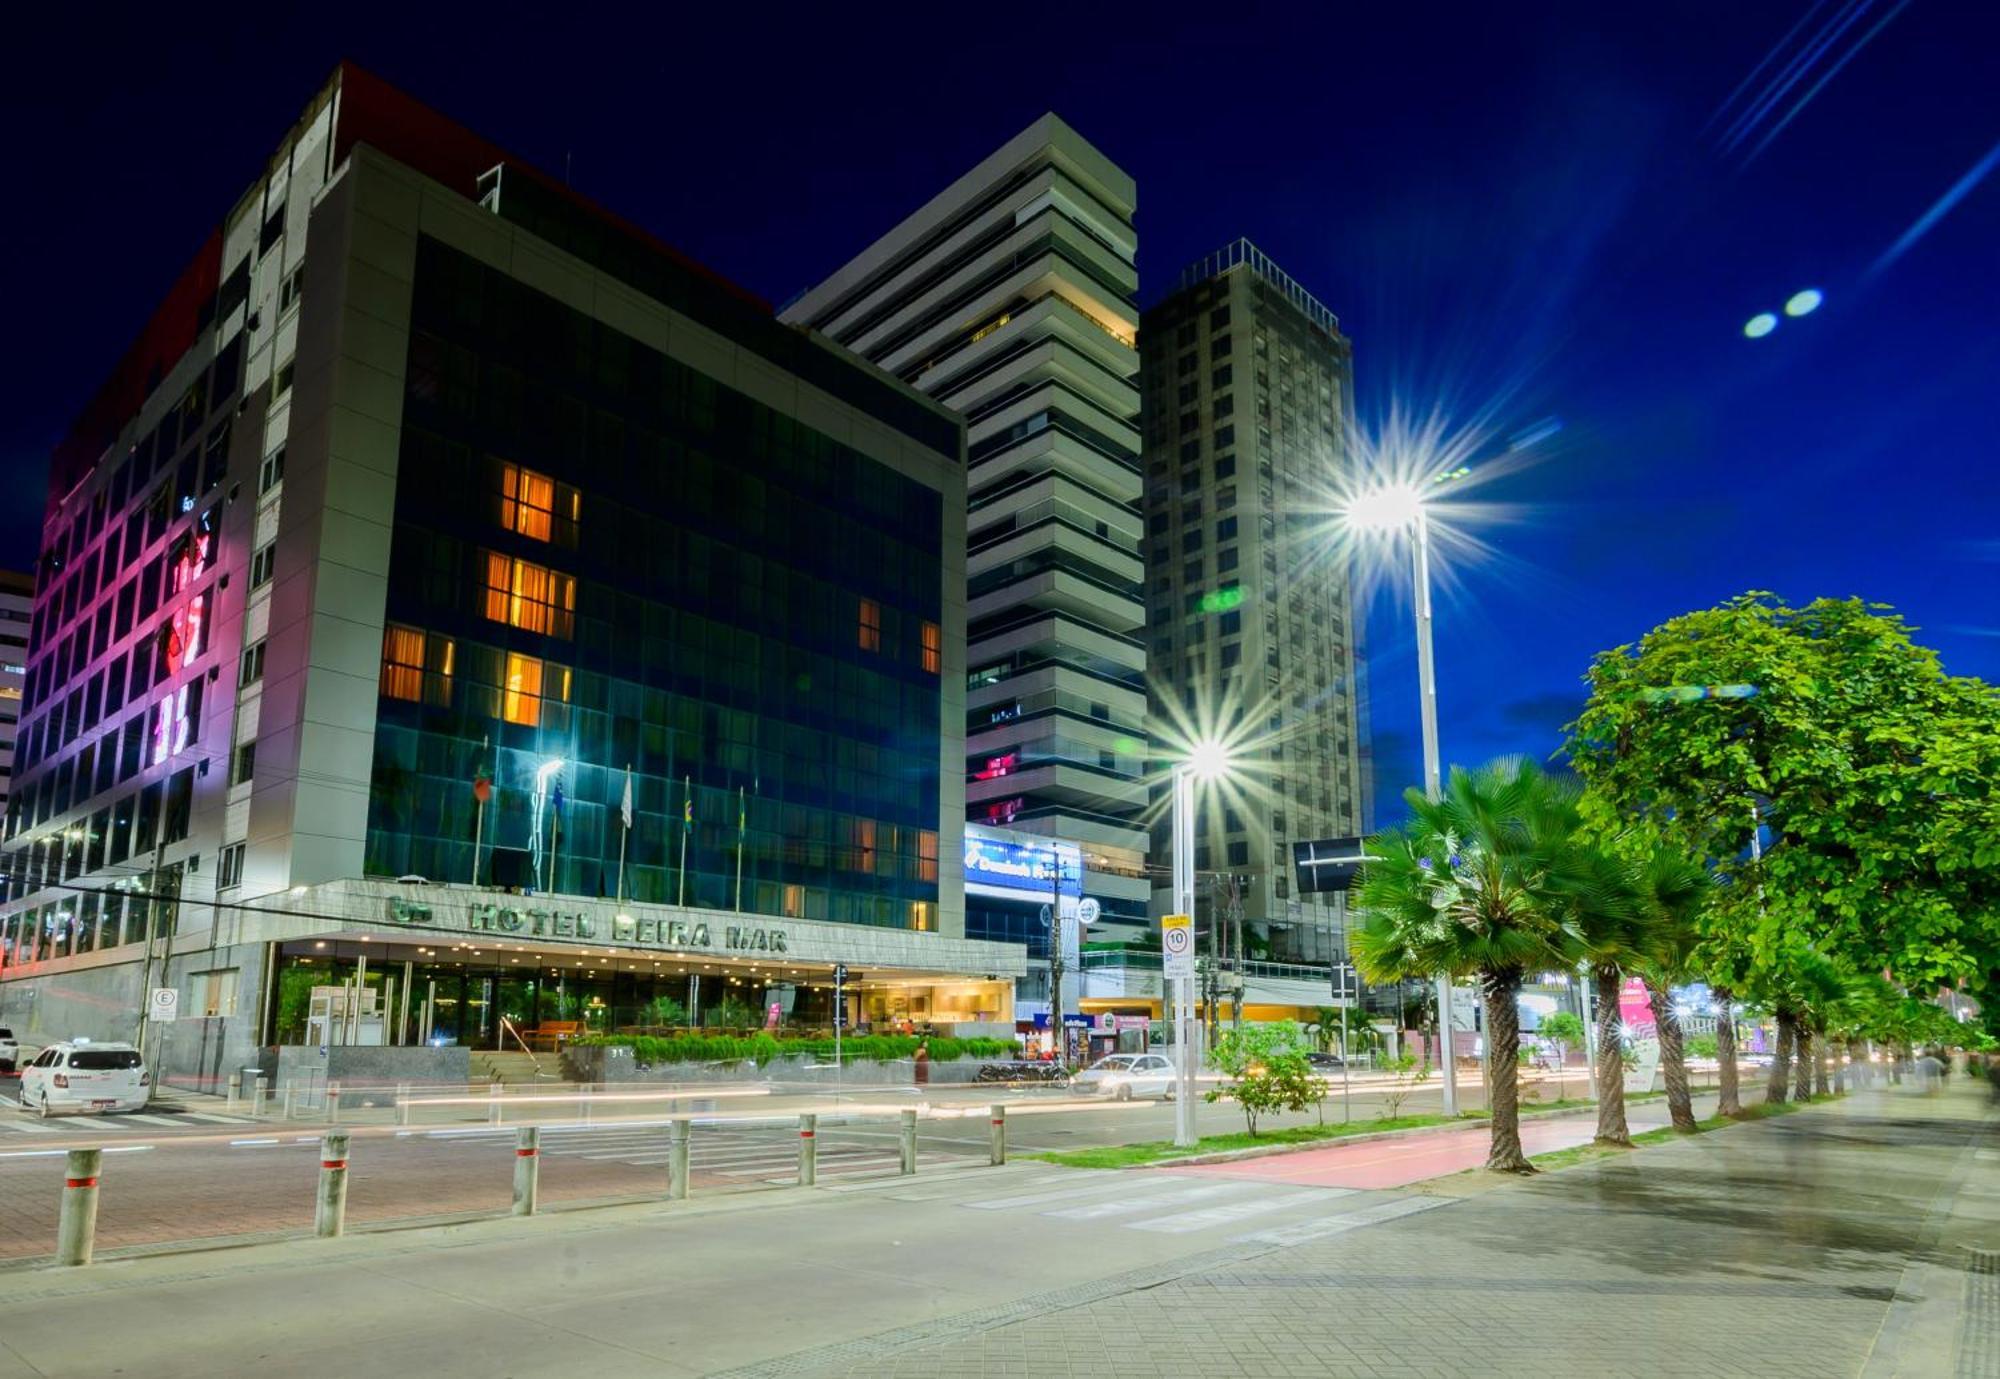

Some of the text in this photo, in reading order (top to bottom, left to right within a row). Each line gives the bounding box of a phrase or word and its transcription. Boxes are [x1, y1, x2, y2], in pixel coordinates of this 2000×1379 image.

[470, 902, 788, 953] HOTEL BEIRA MAR
[1171, 933, 1184, 944] 10
[161, 992, 169, 1004] E
